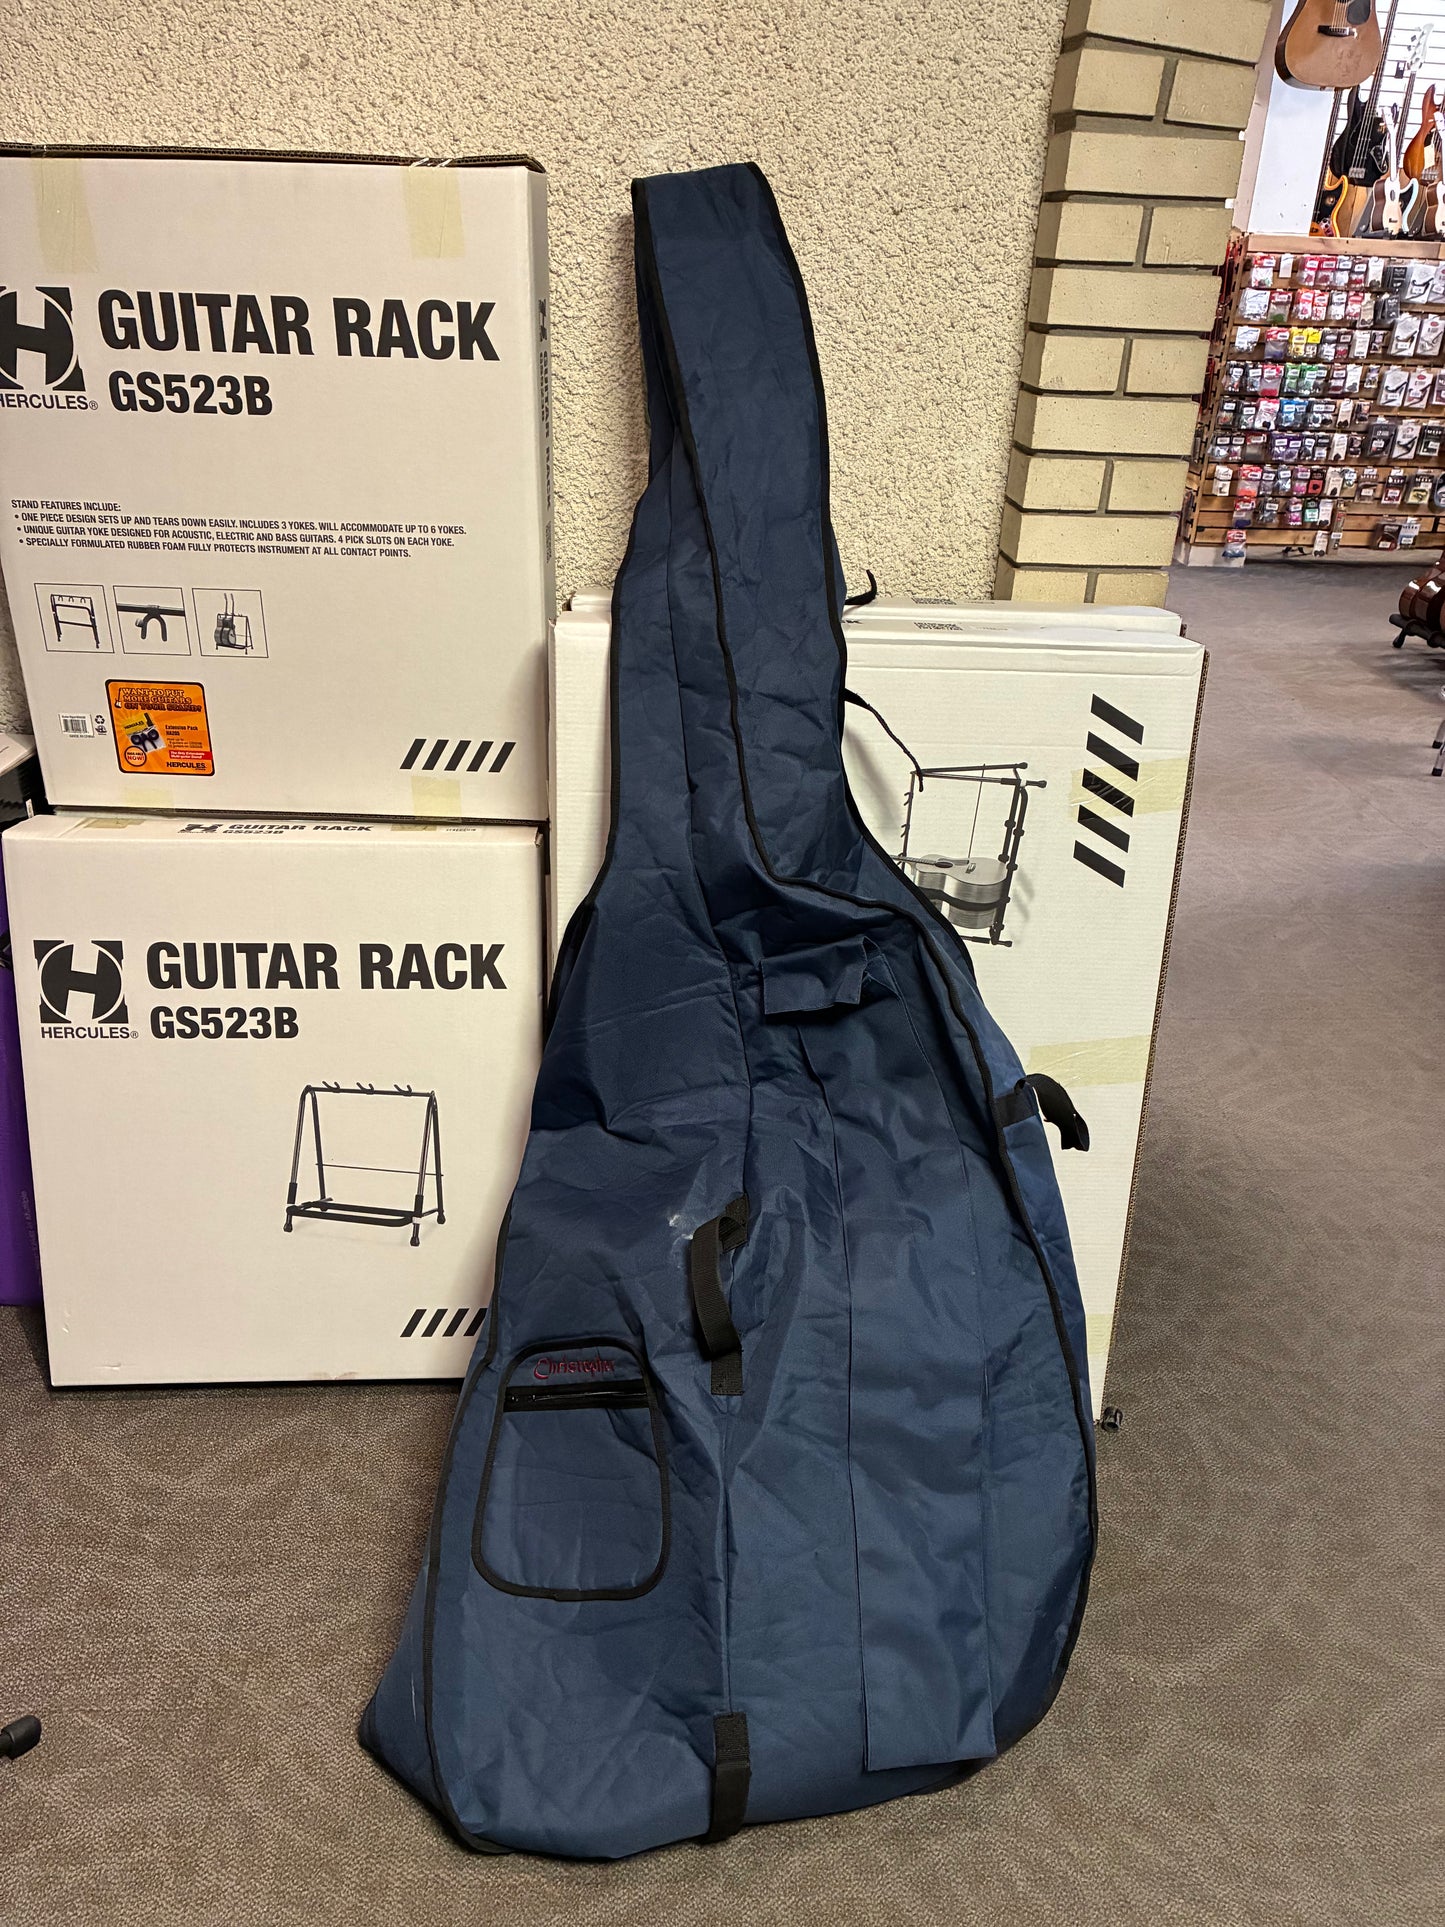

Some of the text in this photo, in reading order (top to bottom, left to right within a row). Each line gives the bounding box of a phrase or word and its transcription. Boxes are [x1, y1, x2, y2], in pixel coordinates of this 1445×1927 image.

[98, 289, 501, 362] GUITAR RACK
[108, 370, 273, 416] GS523B
[12, 499, 121, 512] STAND FEATURES INCLUDE:
[22, 512, 466, 535] ONE PIECE DESIGN SETS UP AND TEARS DOWN EASILY. INCLUDES 3 YOKES. WILL ACCOMMODATE UP TO 6 YOKES.
[24, 525, 454, 546] UNIQUE GUITAR YOKE DESIGNED FOR ACOUSTIC, ELECTRIC AND BASS GUITARS. 4 PICK SLOTS ON EACH YOKE.
[26, 537, 411, 558] SPECIALLY FORMULATED RUBBER FOAM FULLY PROTECTS INSTRUMENT AT ALL CONTACT POINTS.
[146, 941, 507, 990] GUITAR RACK
[149, 1006, 300, 1040] GS523B
